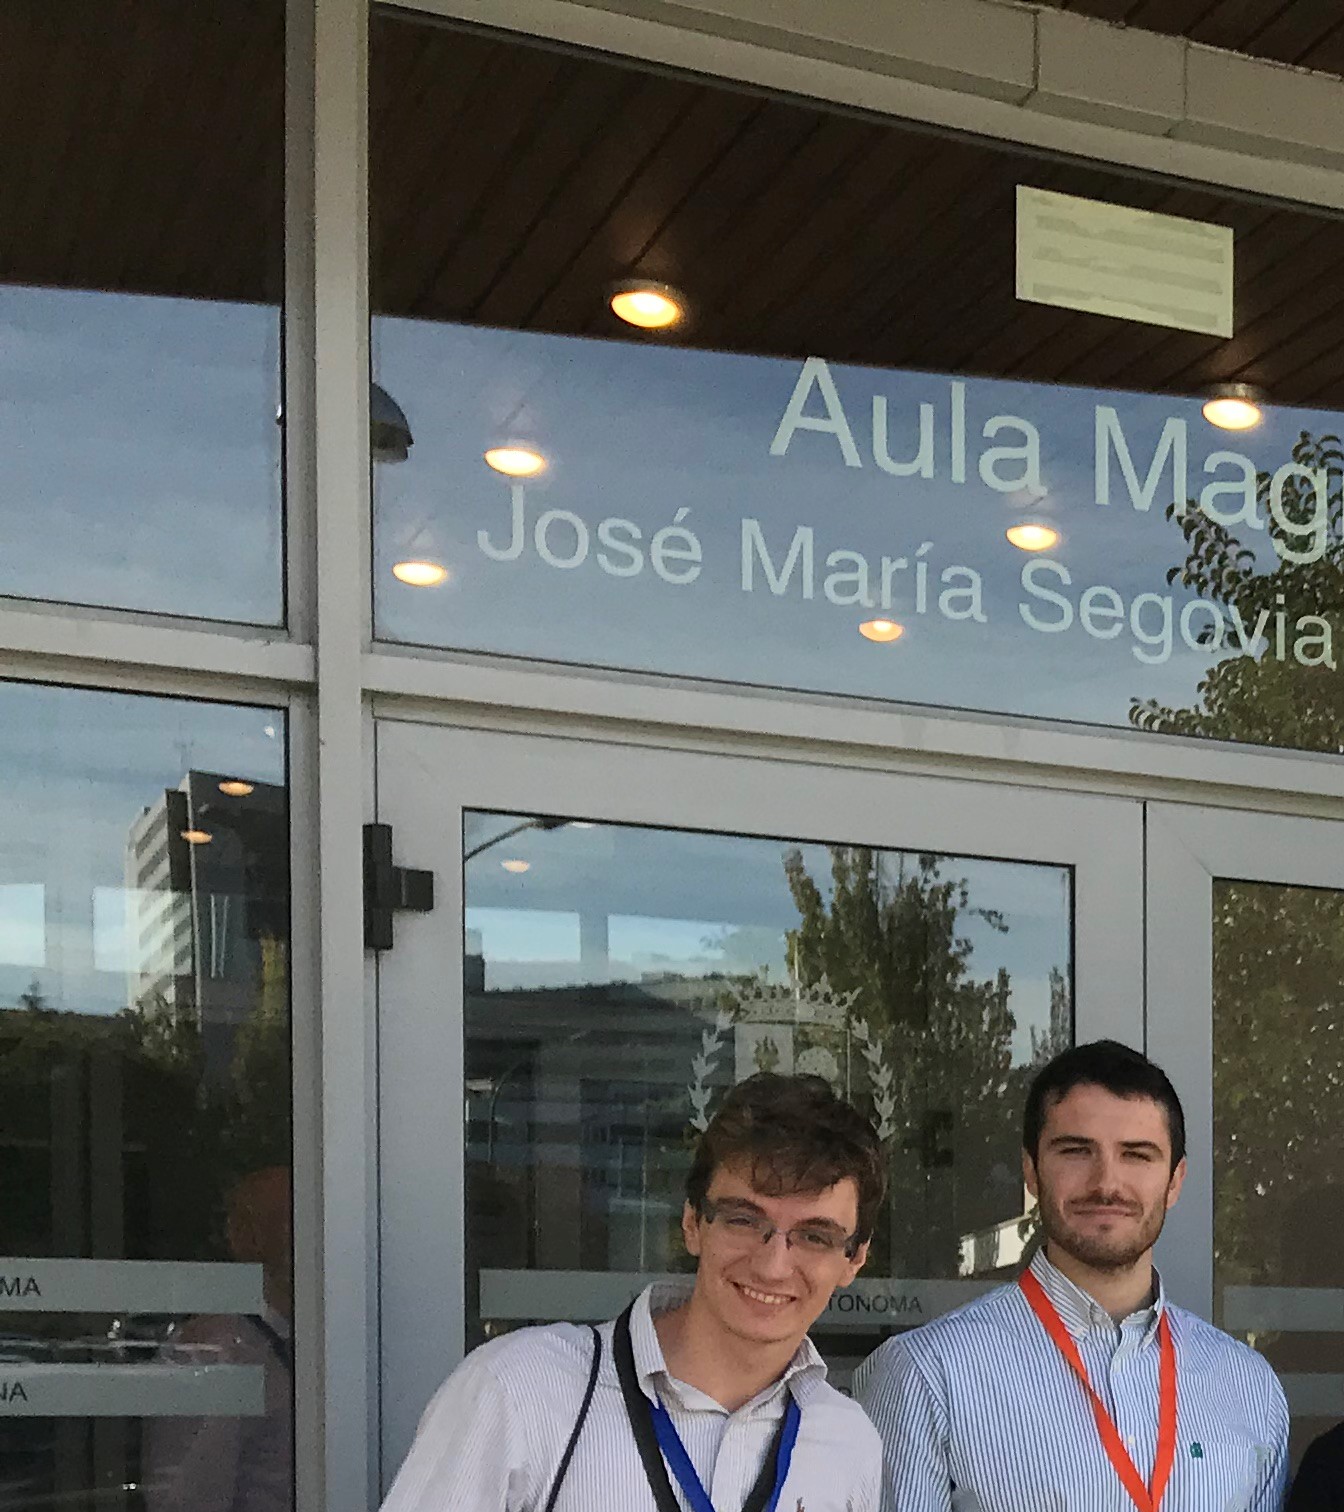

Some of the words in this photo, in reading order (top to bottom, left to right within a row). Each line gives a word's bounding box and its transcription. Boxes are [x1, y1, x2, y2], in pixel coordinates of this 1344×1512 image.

[770, 355, 1047, 498] Aula
[477, 485, 704, 585] José
[741, 518, 986, 626] María
[1017, 557, 1338, 671] Segovia
[829, 1294, 923, 1314] TONOMA
